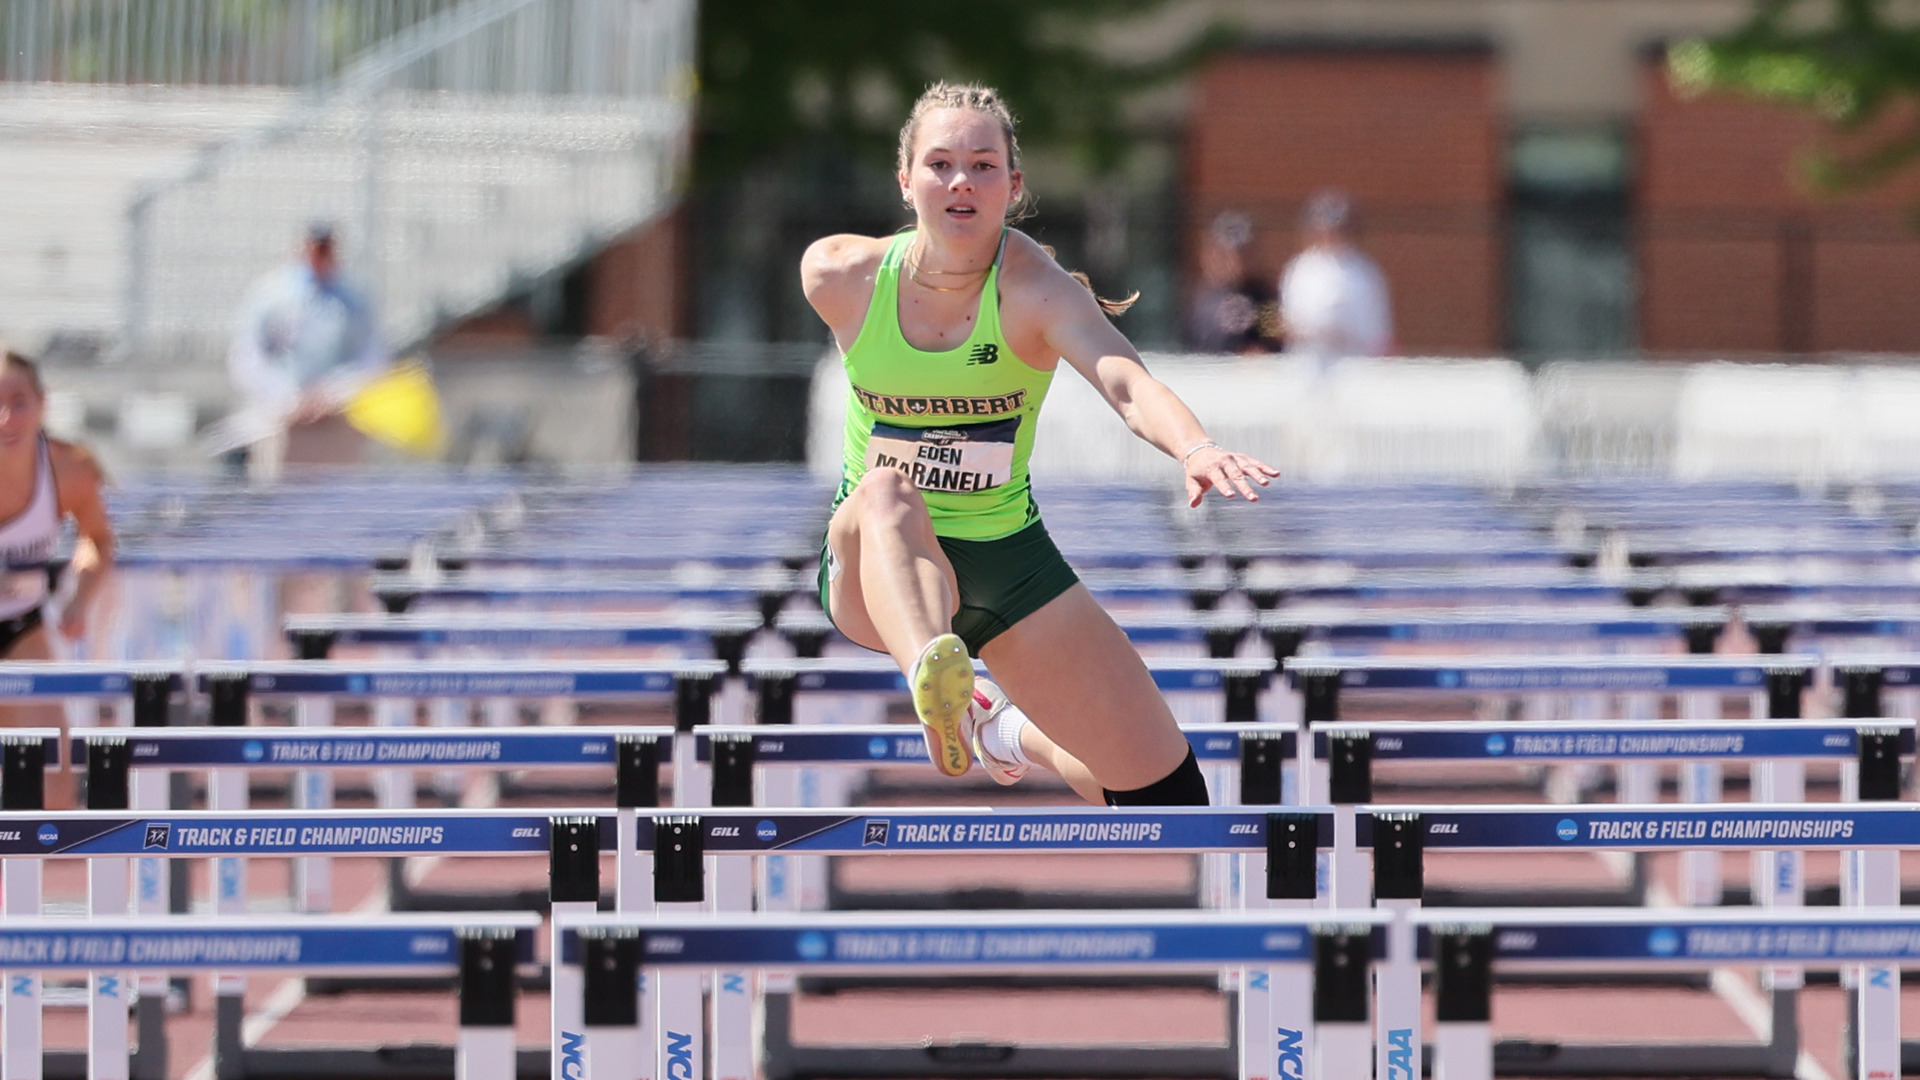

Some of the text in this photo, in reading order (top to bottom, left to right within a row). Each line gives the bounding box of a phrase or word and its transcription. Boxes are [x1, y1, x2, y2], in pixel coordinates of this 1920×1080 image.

[917, 445, 963, 466] EDEN
[178, 826, 444, 846] TRACK & FIELD CHAMPIONSHIPS
[511, 827, 541, 838] GILL
[710, 826, 740, 837] GILL
[897, 823, 1162, 842] TRACK & FIELD CHAMPIONSHIPS
[1229, 824, 1259, 834] GILL
[1429, 823, 1459, 834] GILL
[1589, 820, 1854, 840] TRACK & FIELD CHAMPIONSHIPS
